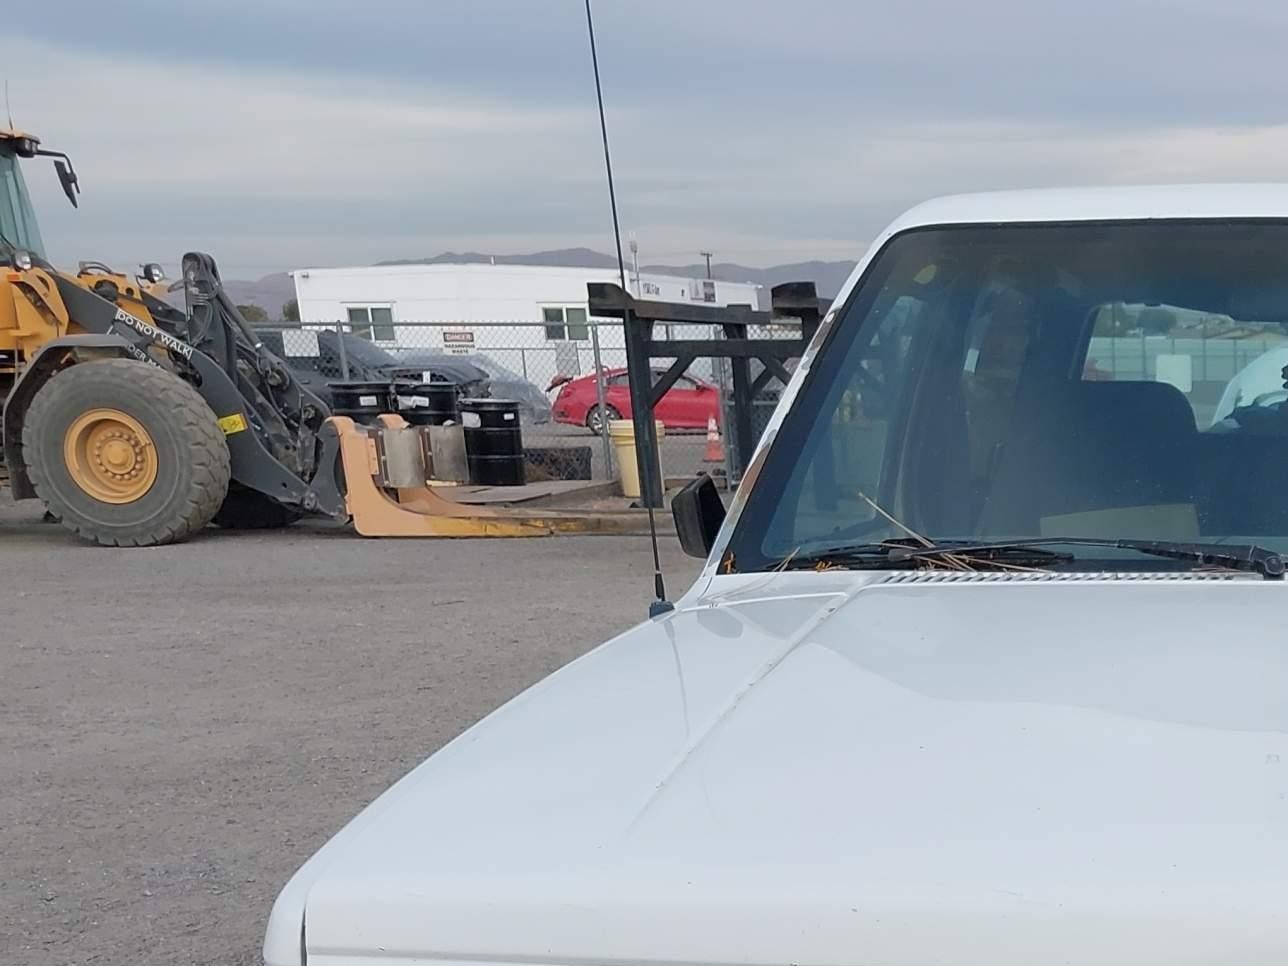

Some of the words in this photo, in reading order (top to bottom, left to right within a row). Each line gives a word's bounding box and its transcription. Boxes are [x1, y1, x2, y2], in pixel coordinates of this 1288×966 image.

[117, 310, 134, 325] DO
[135, 320, 158, 338] NOT
[160, 334, 190, 358] WALK
